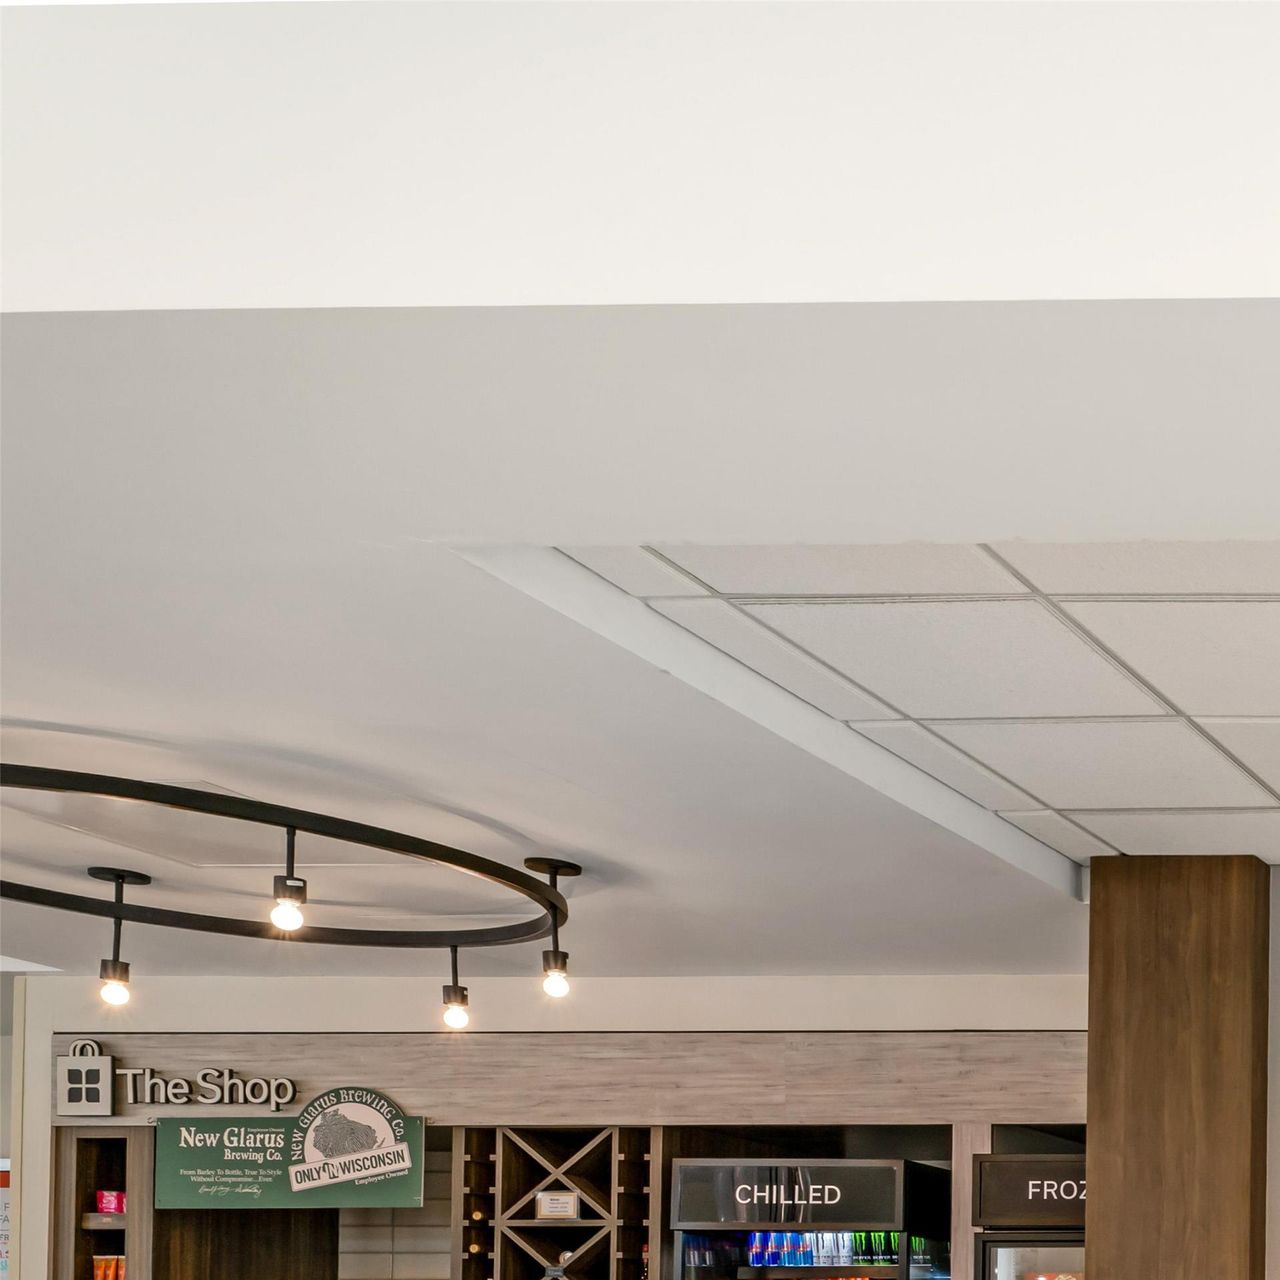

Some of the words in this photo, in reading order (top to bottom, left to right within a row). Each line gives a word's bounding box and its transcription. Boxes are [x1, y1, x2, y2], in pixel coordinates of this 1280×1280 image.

[115, 1068, 192, 1104] The
[196, 1068, 294, 1111] Shop
[179, 1127, 221, 1148] New
[223, 1127, 285, 1148] Glarus
[223, 1149, 264, 1164] Brewing
[266, 1149, 283, 1161] Co.
[295, 1166, 322, 1184] ONLY
[340, 1149, 406, 1175] WISCONSIN
[354, 1175, 385, 1185] Employee
[735, 1184, 841, 1204] CHILLED
